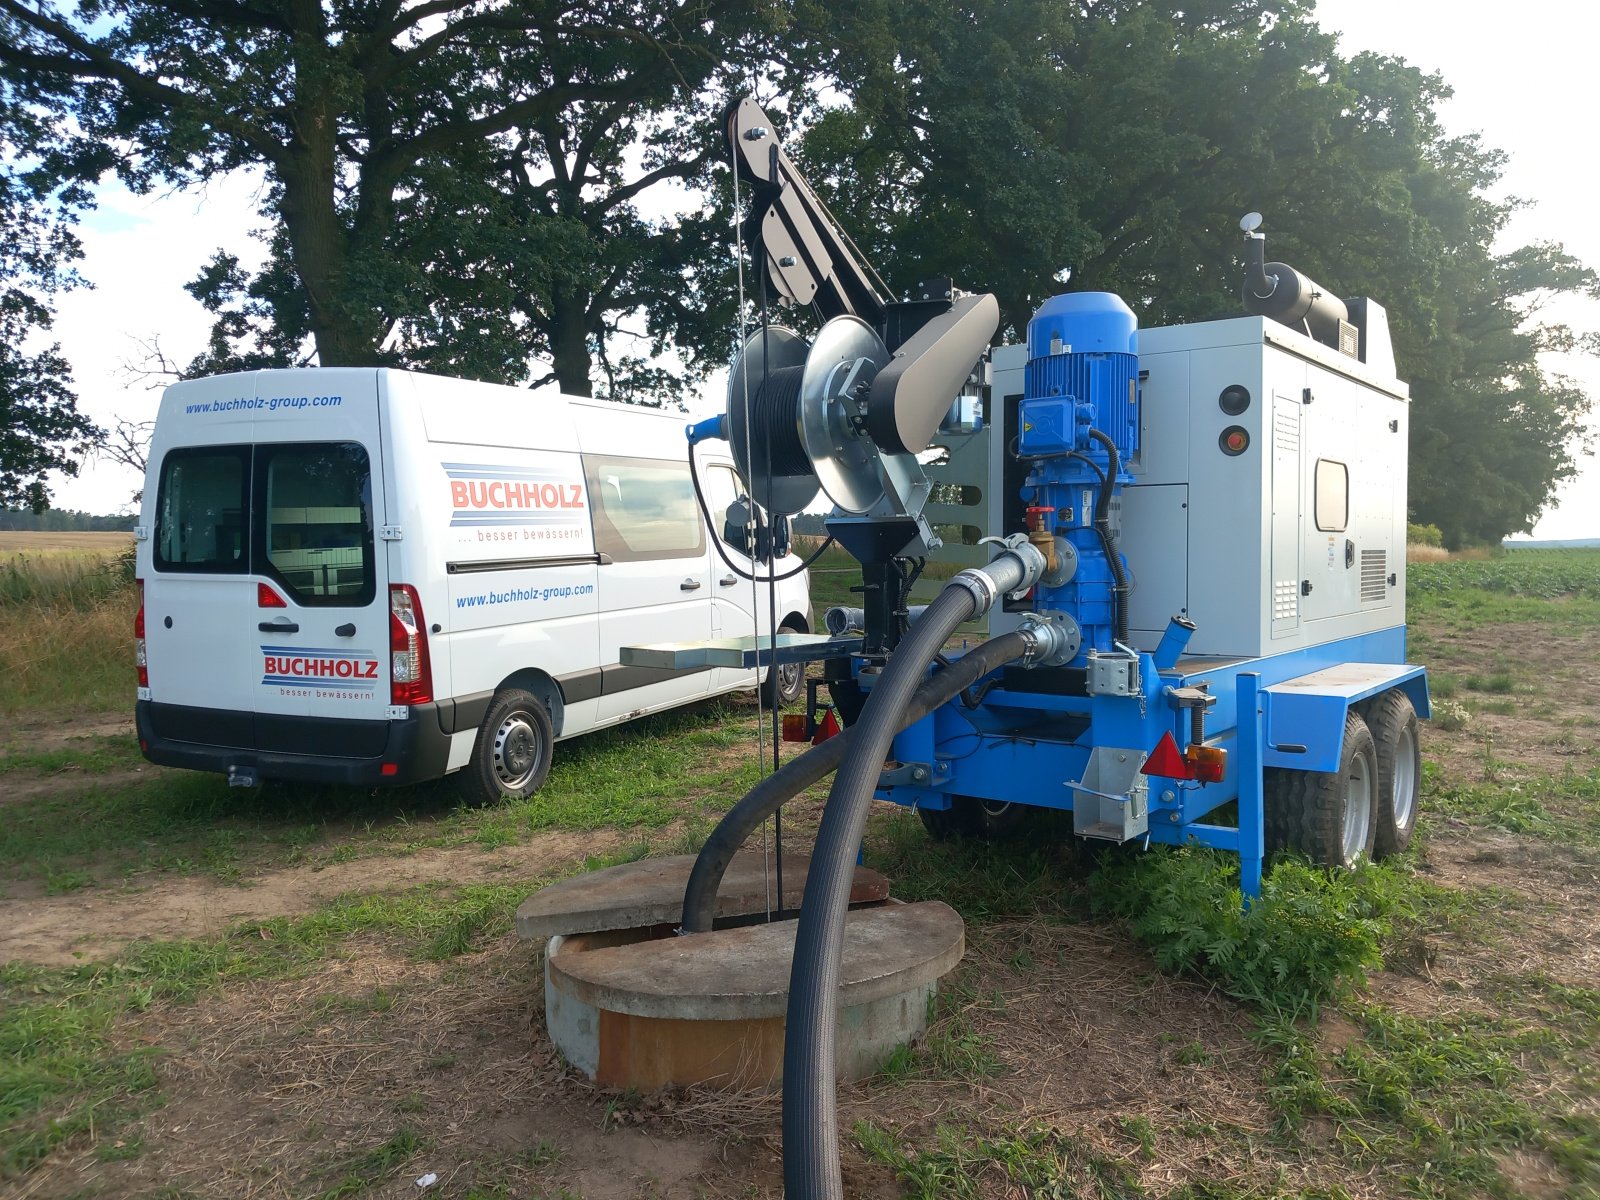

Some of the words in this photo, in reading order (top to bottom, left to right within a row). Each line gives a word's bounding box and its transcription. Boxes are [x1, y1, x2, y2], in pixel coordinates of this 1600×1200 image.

[186, 396, 342, 414] www.buchholz-group.com
[450, 481, 584, 508] BUCHHOLZ
[477, 529, 518, 542] besser
[523, 528, 584, 540] bewässern!
[457, 584, 594, 608] www.buchholz-group.com
[264, 656, 379, 679] BUCHHOLZ
[280, 688, 312, 697] besser
[316, 690, 375, 700] bewässern!
